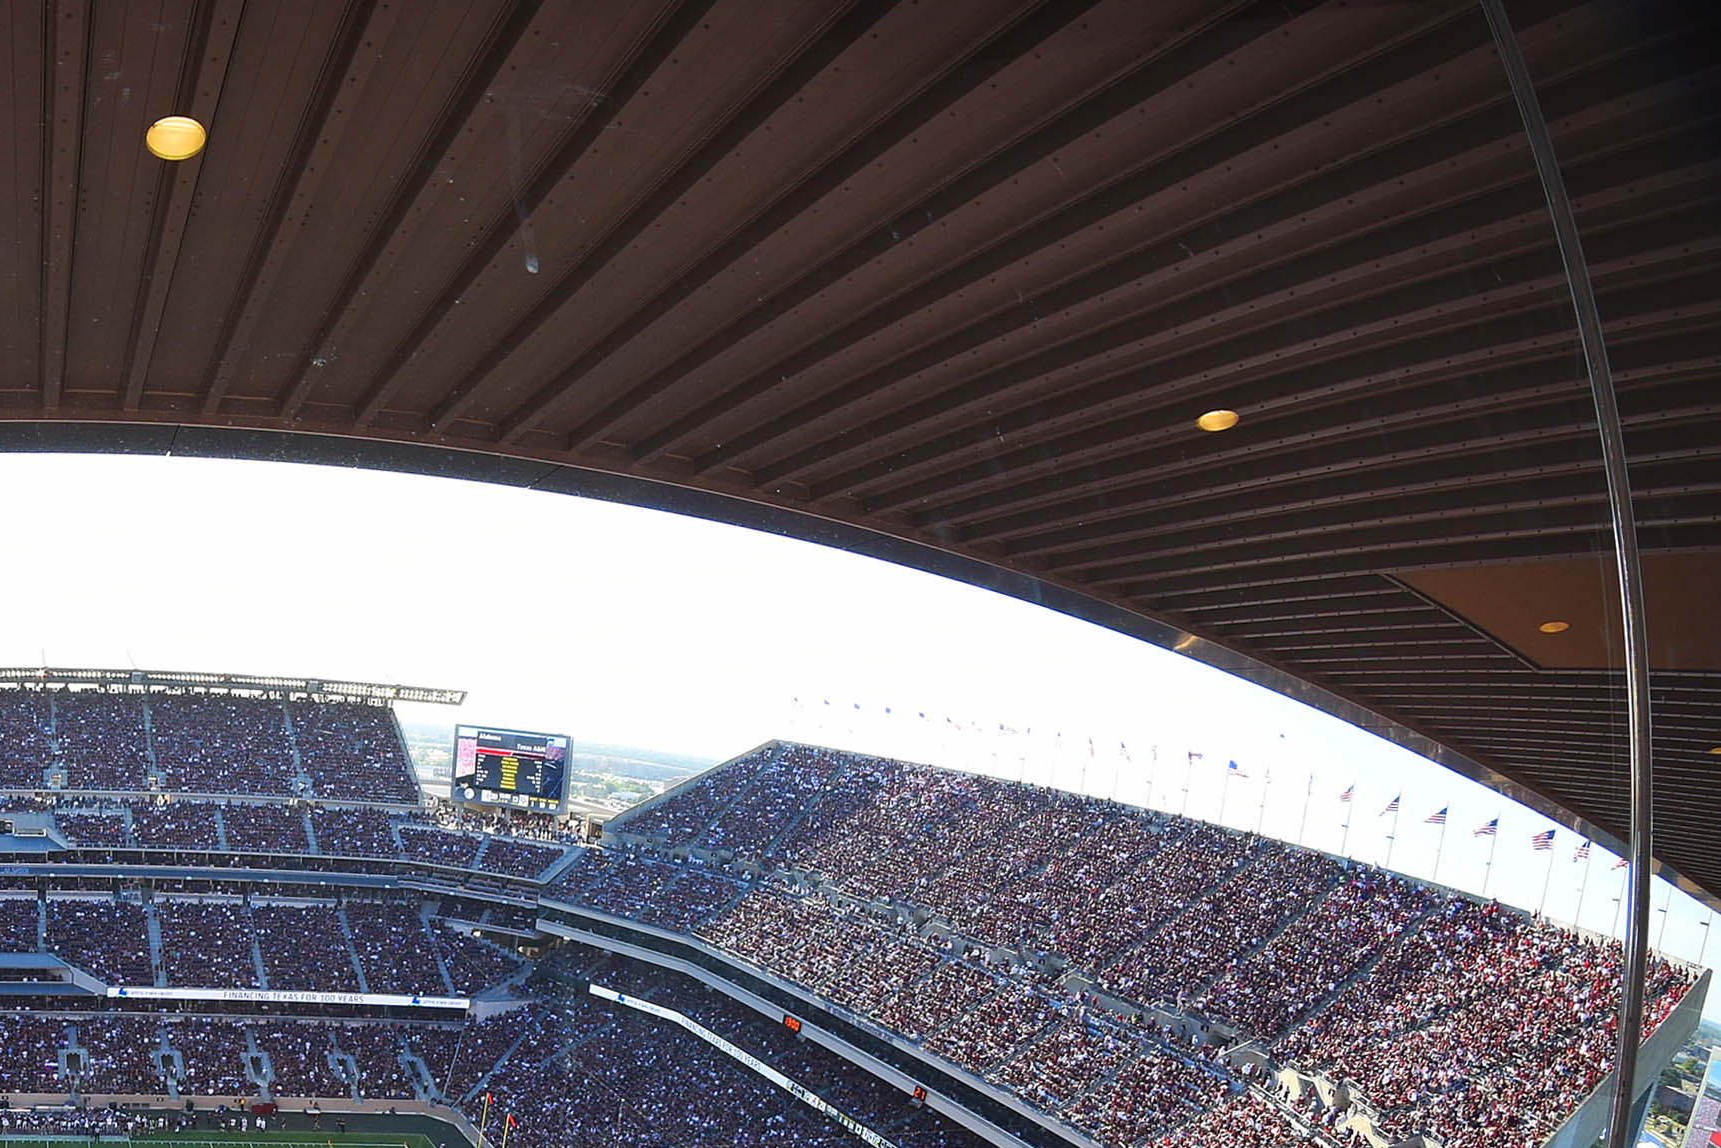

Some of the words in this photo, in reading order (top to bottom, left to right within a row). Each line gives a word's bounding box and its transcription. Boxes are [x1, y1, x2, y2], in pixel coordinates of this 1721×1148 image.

[223, 991, 270, 1000] FINANCING
[272, 992, 299, 1000] TEXAS
[301, 993, 318, 1001] FOR
[320, 994, 336, 1002] 100
[338, 995, 364, 1003] YEARS
[914, 1087, 925, 1100] 21
